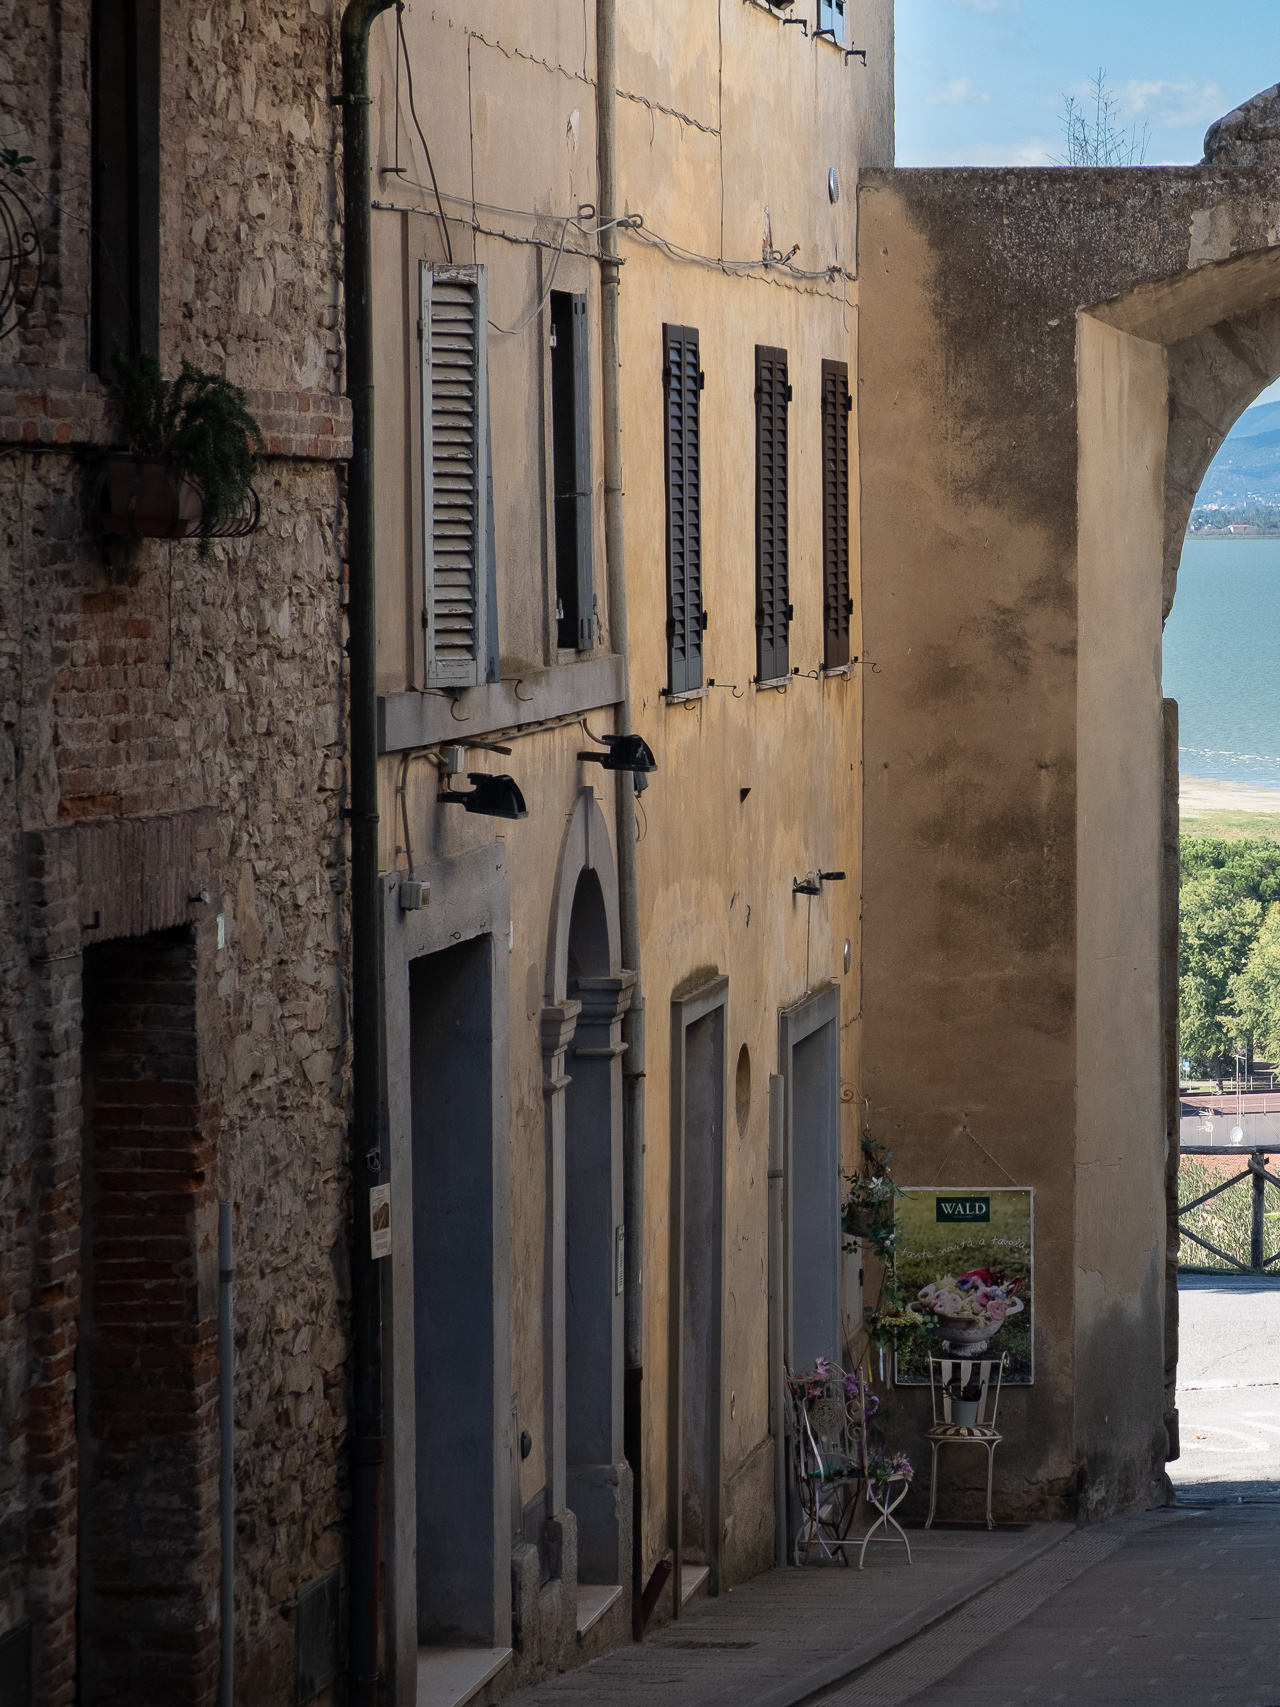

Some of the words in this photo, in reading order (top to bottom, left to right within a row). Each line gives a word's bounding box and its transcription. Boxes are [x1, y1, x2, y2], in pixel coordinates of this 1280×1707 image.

[940, 1202, 986, 1215] WALD
[901, 1247, 934, 1259] tante
[938, 1237, 974, 1255] novità
[978, 1238, 985, 1246] a
[991, 1235, 1026, 1249] tavola
